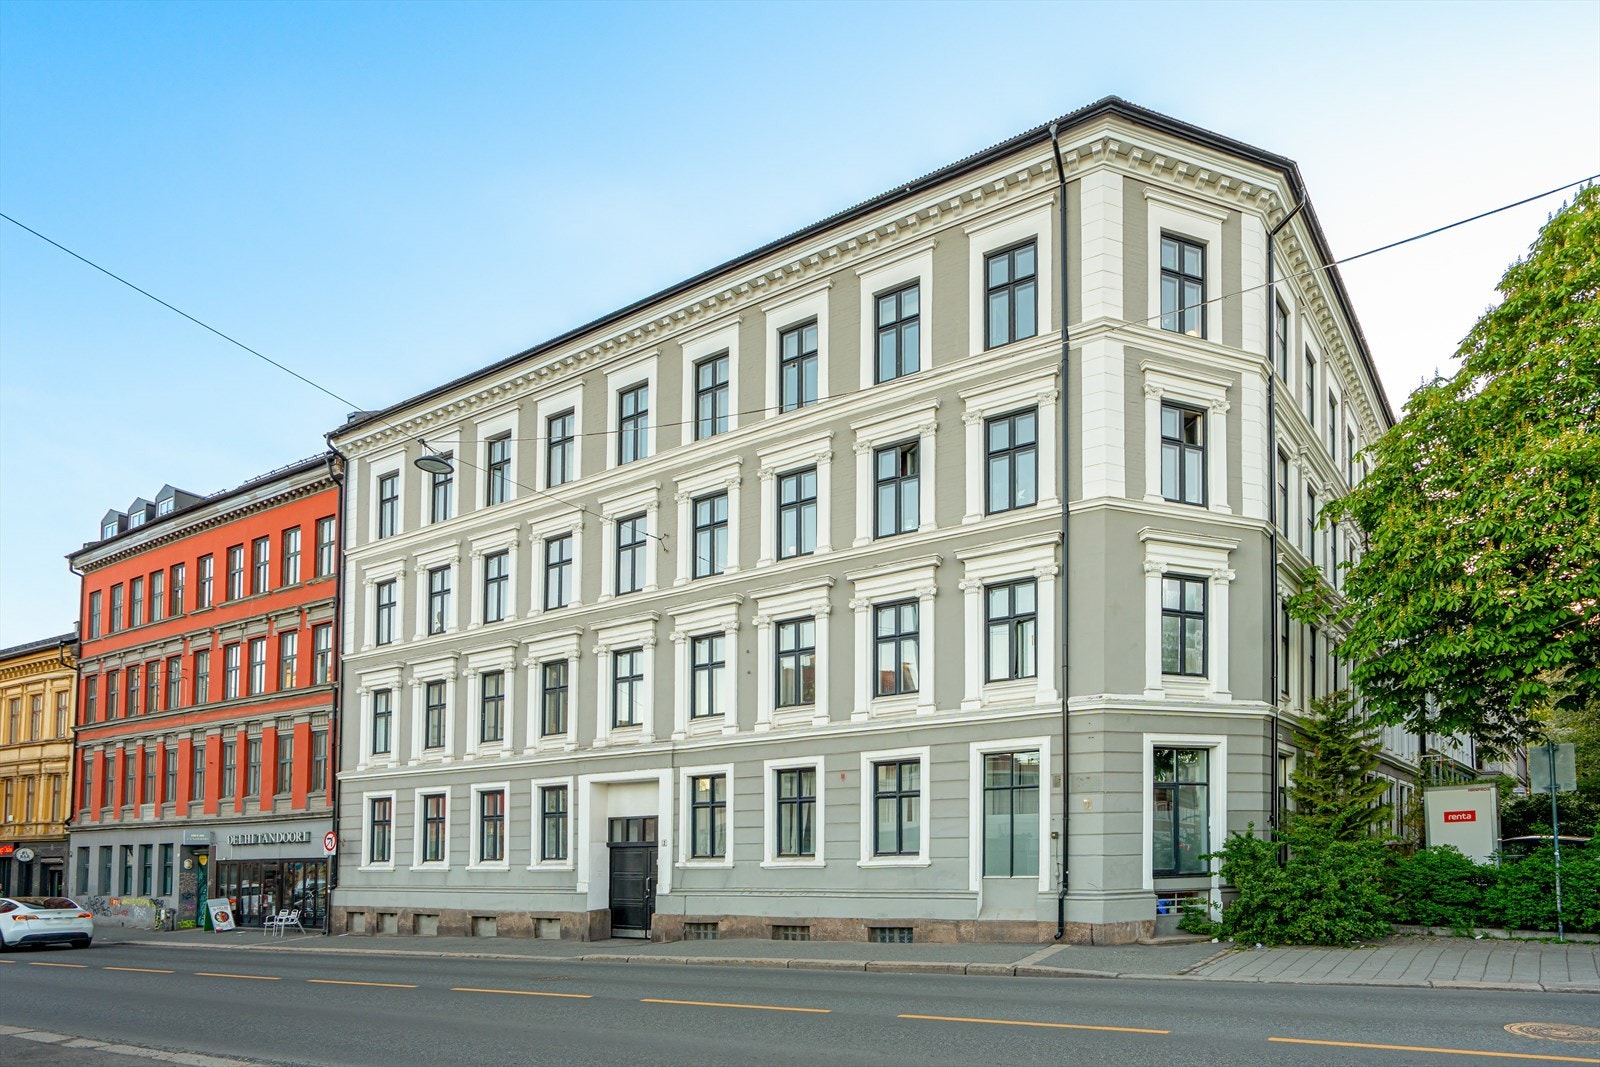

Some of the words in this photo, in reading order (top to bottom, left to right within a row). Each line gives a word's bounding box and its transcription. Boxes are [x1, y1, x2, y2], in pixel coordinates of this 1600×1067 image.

[1448, 813, 1472, 821] renta
[226, 834, 255, 845] DELHI
[256, 831, 307, 844] TANDOORI
